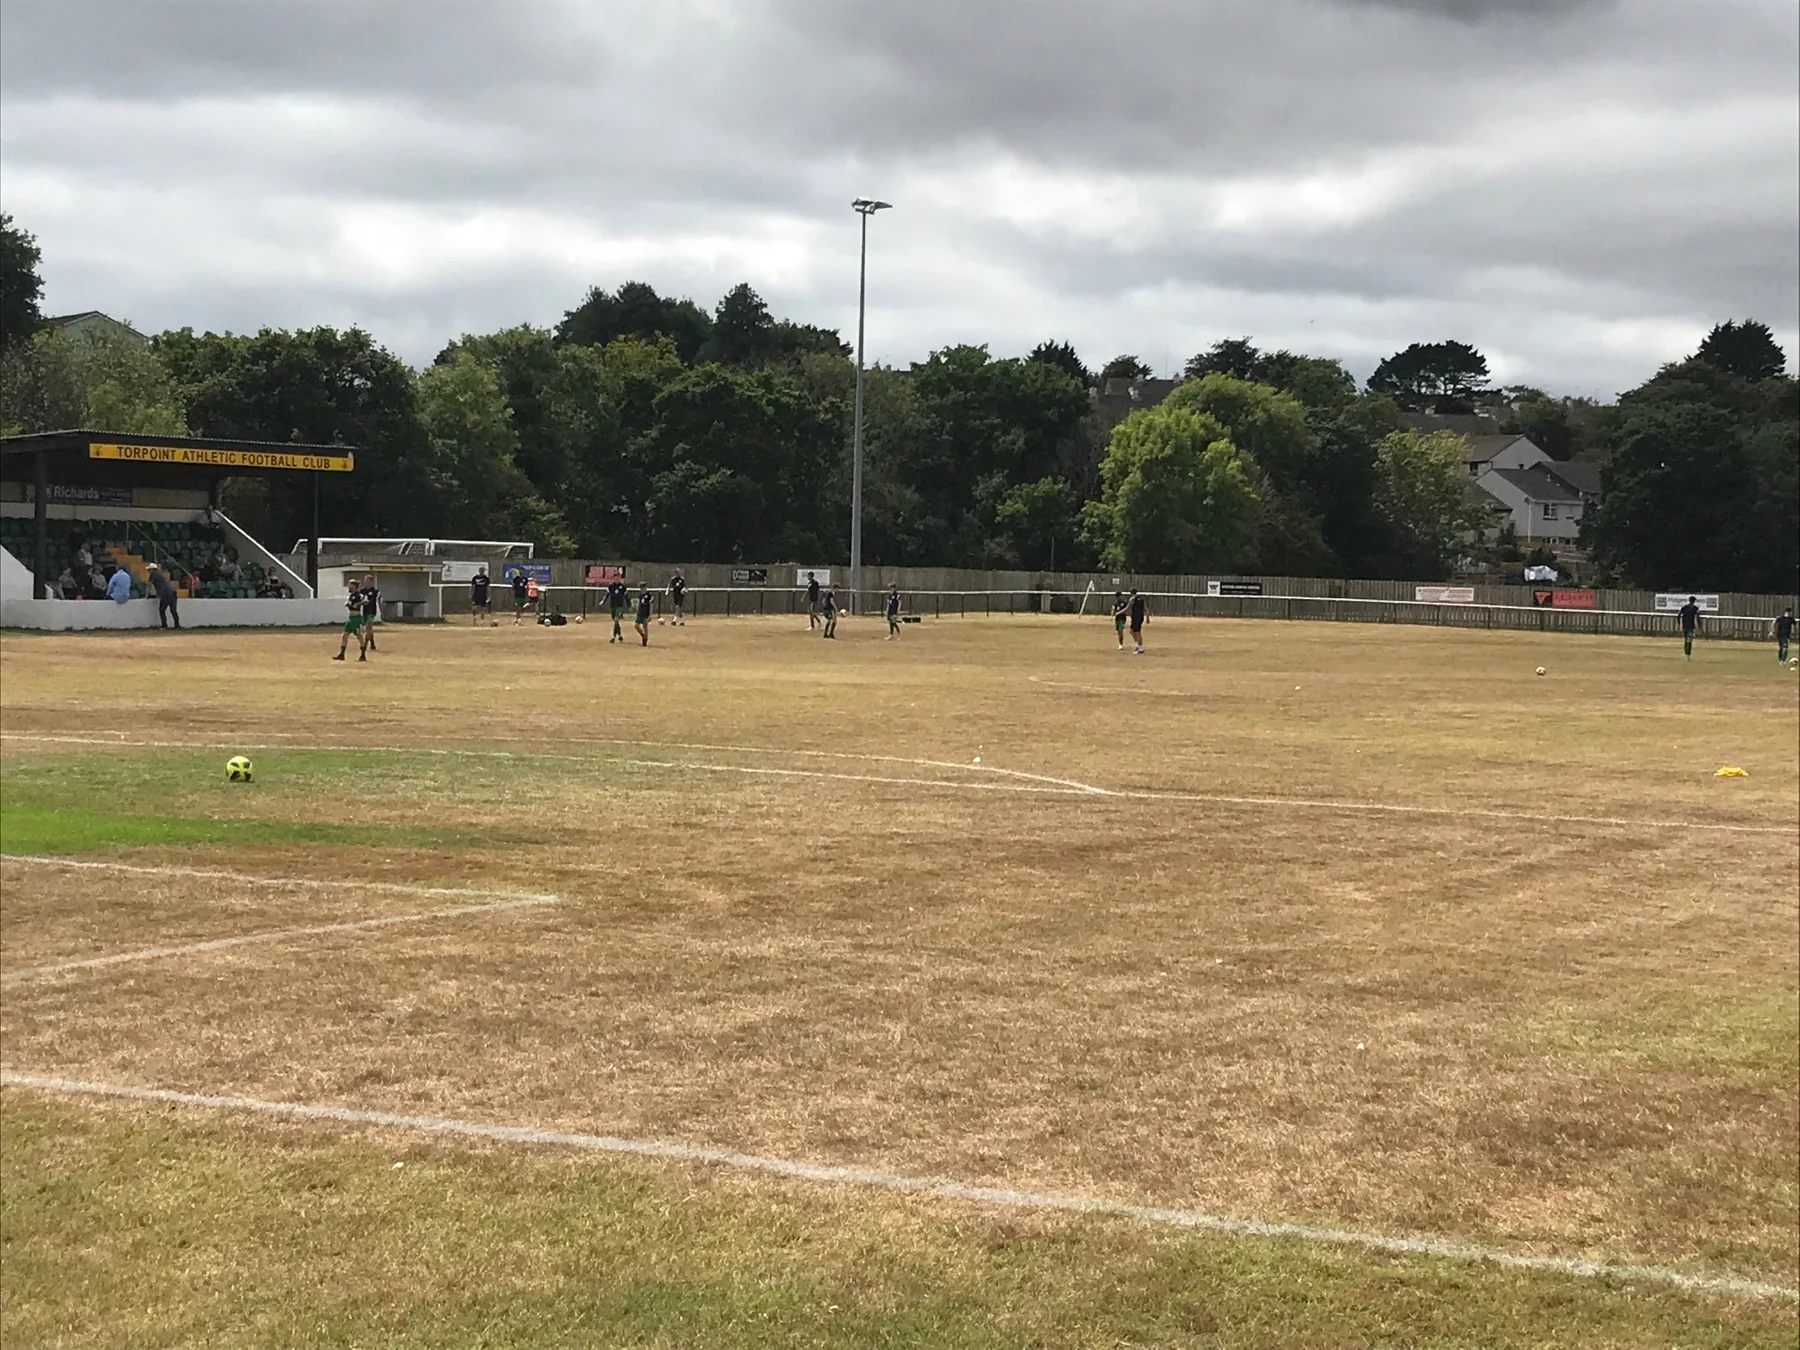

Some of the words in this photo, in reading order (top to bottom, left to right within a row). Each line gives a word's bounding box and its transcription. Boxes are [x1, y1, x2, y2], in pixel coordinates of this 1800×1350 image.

[117, 446, 177, 461] TORPOINT
[182, 450, 236, 464] ATHLETIC
[242, 453, 298, 468] FOOTBALL
[302, 457, 331, 469] CLUB
[54, 485, 100, 500] Richards
